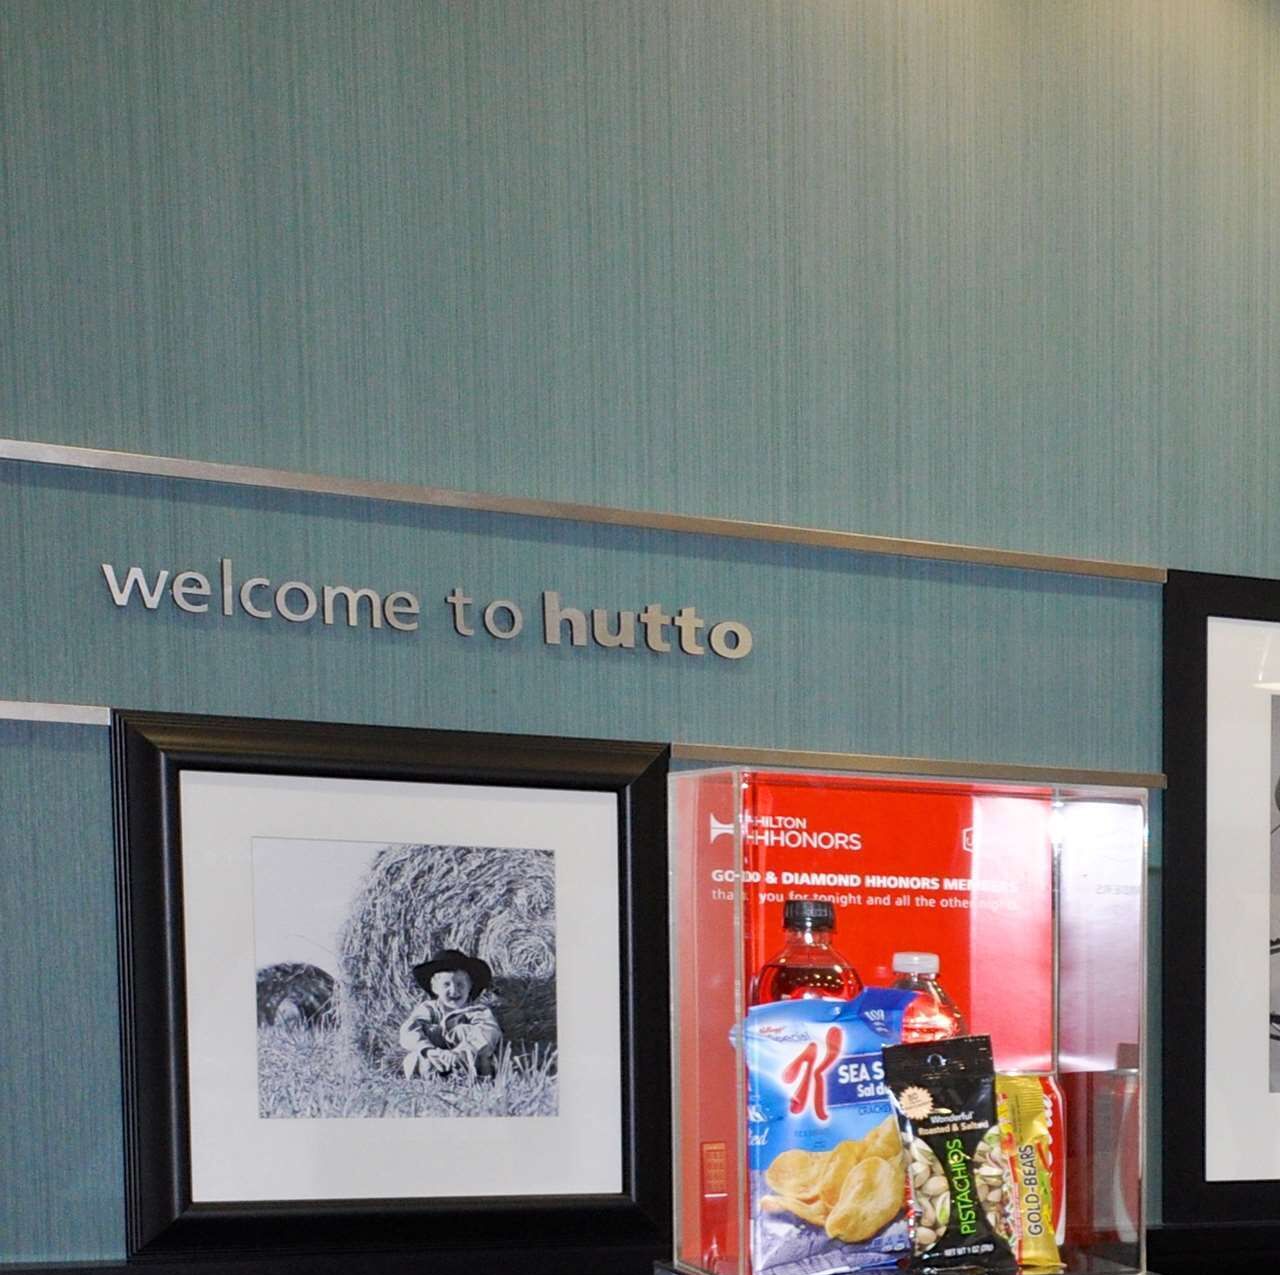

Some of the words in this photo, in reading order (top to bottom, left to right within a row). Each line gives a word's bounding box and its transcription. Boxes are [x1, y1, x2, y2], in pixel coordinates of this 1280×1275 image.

[101, 557, 421, 632] welcome
[444, 586, 523, 641] to
[541, 589, 754, 661] hutto
[758, 891, 784, 904] you
[788, 890, 808, 901] for
[813, 891, 862, 907] tonight
[866, 895, 891, 907] and
[895, 895, 910, 907] all
[915, 896, 935, 908] the
[940, 897, 980, 909] othe
[765, 871, 778, 884] &
[781, 872, 861, 887] DIAMOND
[864, 875, 940, 890] HHONORS
[781, 1025, 844, 1121] K
[837, 1062, 871, 1084] SEA
[857, 1082, 875, 1098] Sal
[945, 1138, 977, 1235] PISTACHIOS
[1018, 1144, 1044, 1236] GOLD-BEARS
